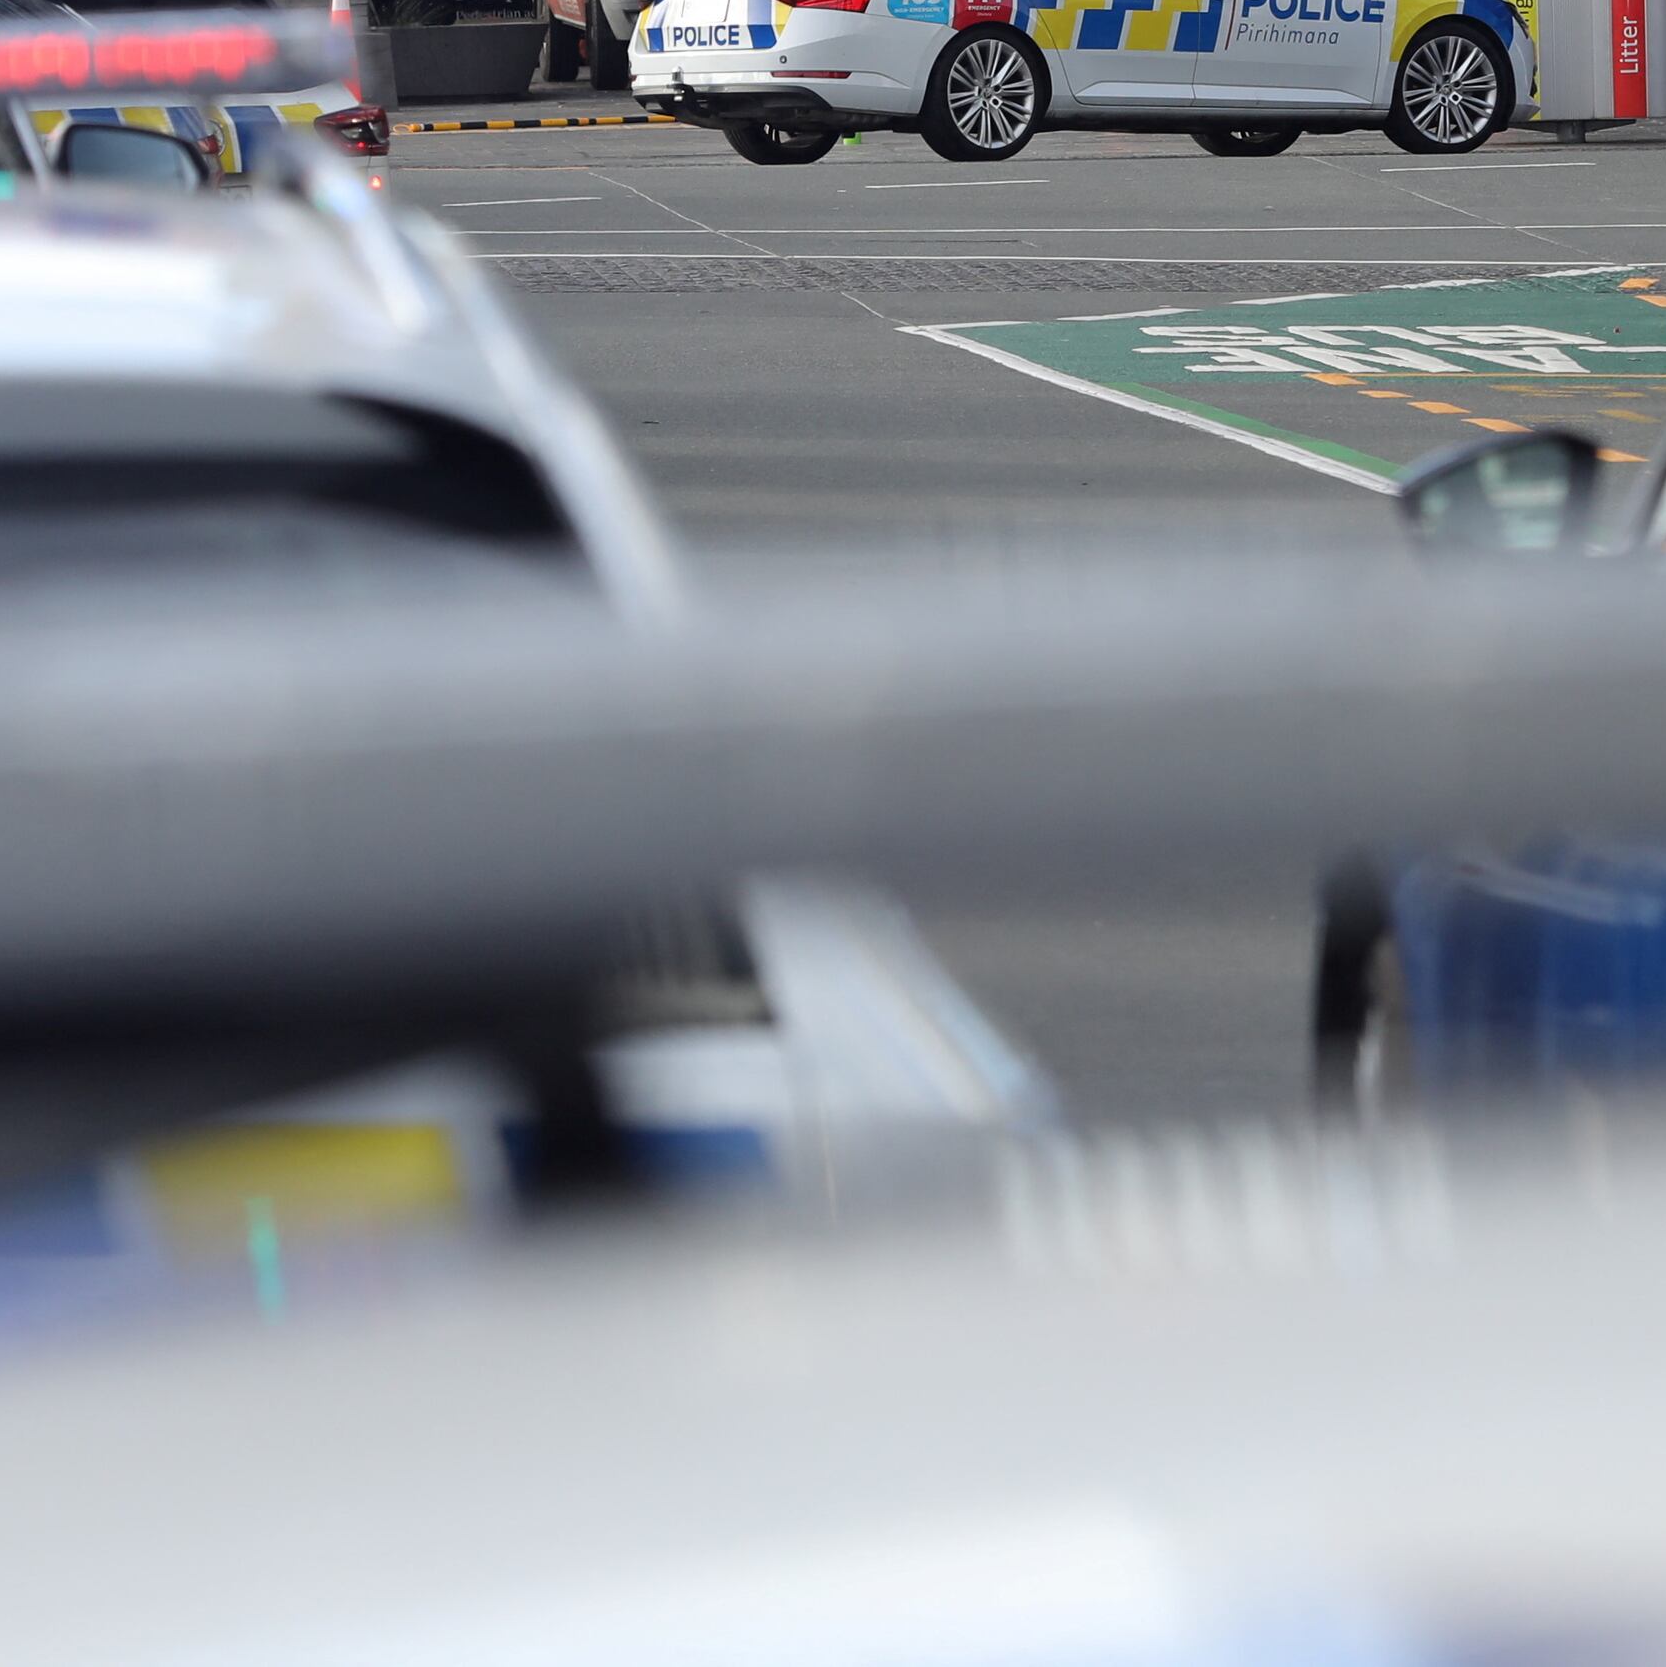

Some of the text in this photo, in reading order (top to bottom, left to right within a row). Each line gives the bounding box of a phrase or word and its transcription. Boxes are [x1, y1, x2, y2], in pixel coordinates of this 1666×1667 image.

[673, 24, 740, 47] POLICE
[1236, 23, 1340, 45] Pirihimana
[1619, 16, 1639, 75] Litter
[1138, 325, 1607, 347] BUS
